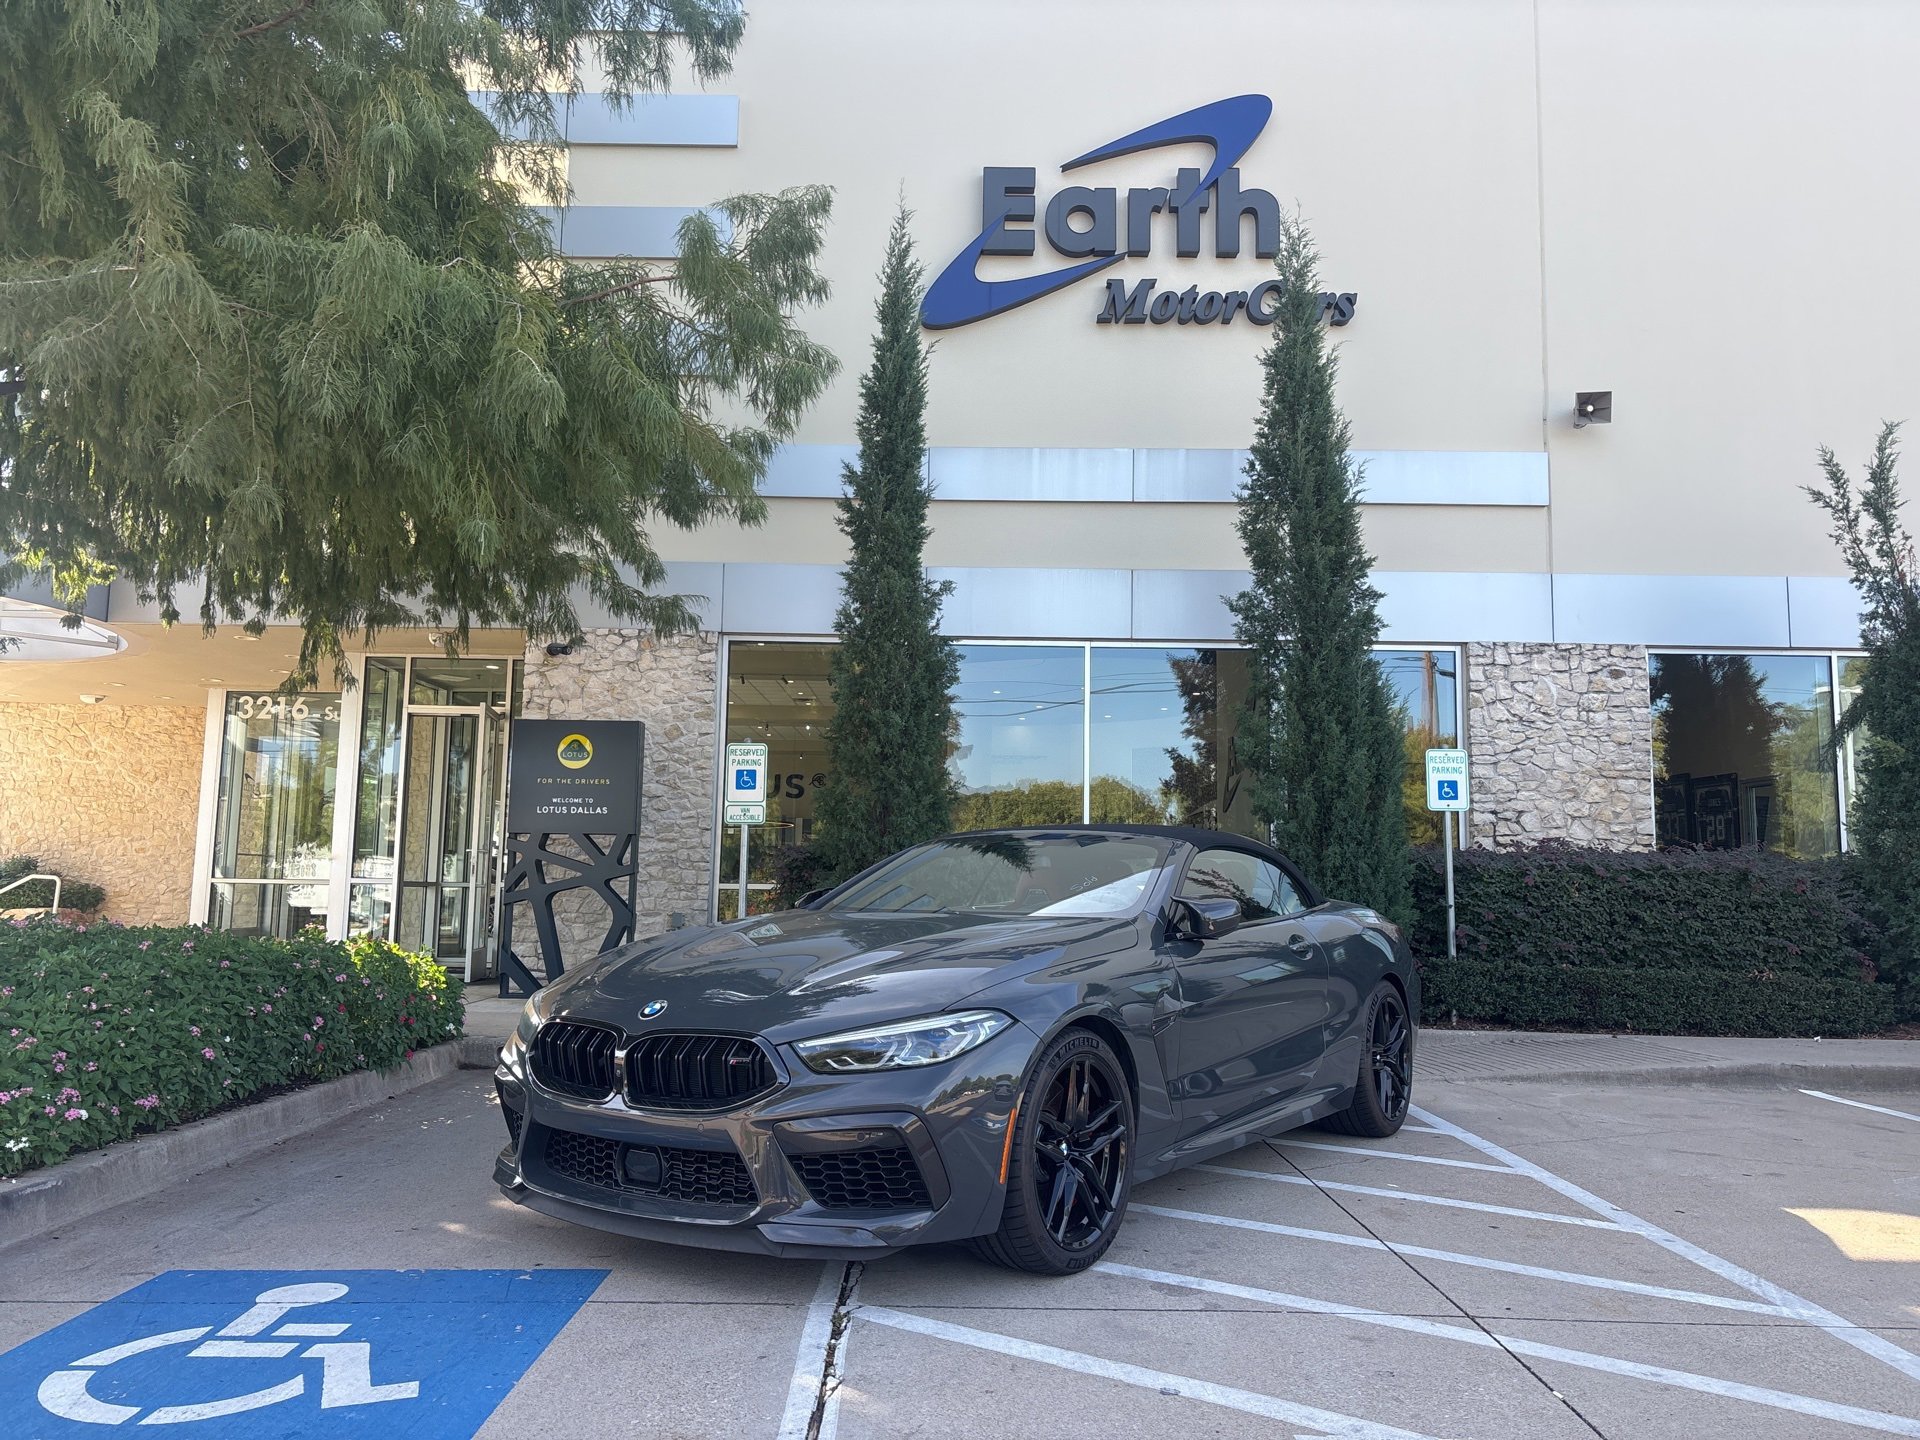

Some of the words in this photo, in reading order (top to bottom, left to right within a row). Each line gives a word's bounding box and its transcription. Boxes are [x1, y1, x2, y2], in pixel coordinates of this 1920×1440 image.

[981, 166, 1281, 259] Earth
[1096, 278, 1358, 327] MotorCrs
[238, 695, 309, 720] 3216
[730, 748, 765, 757] RESERVED
[731, 759, 762, 767] PARKING
[1429, 756, 1465, 764] RESERVED
[1432, 766, 1463, 775] PARKING
[536, 806, 568, 814] LOTUS
[570, 806, 608, 814] DALLAS
[1059, 1036, 1098, 1058] MICHELIN
